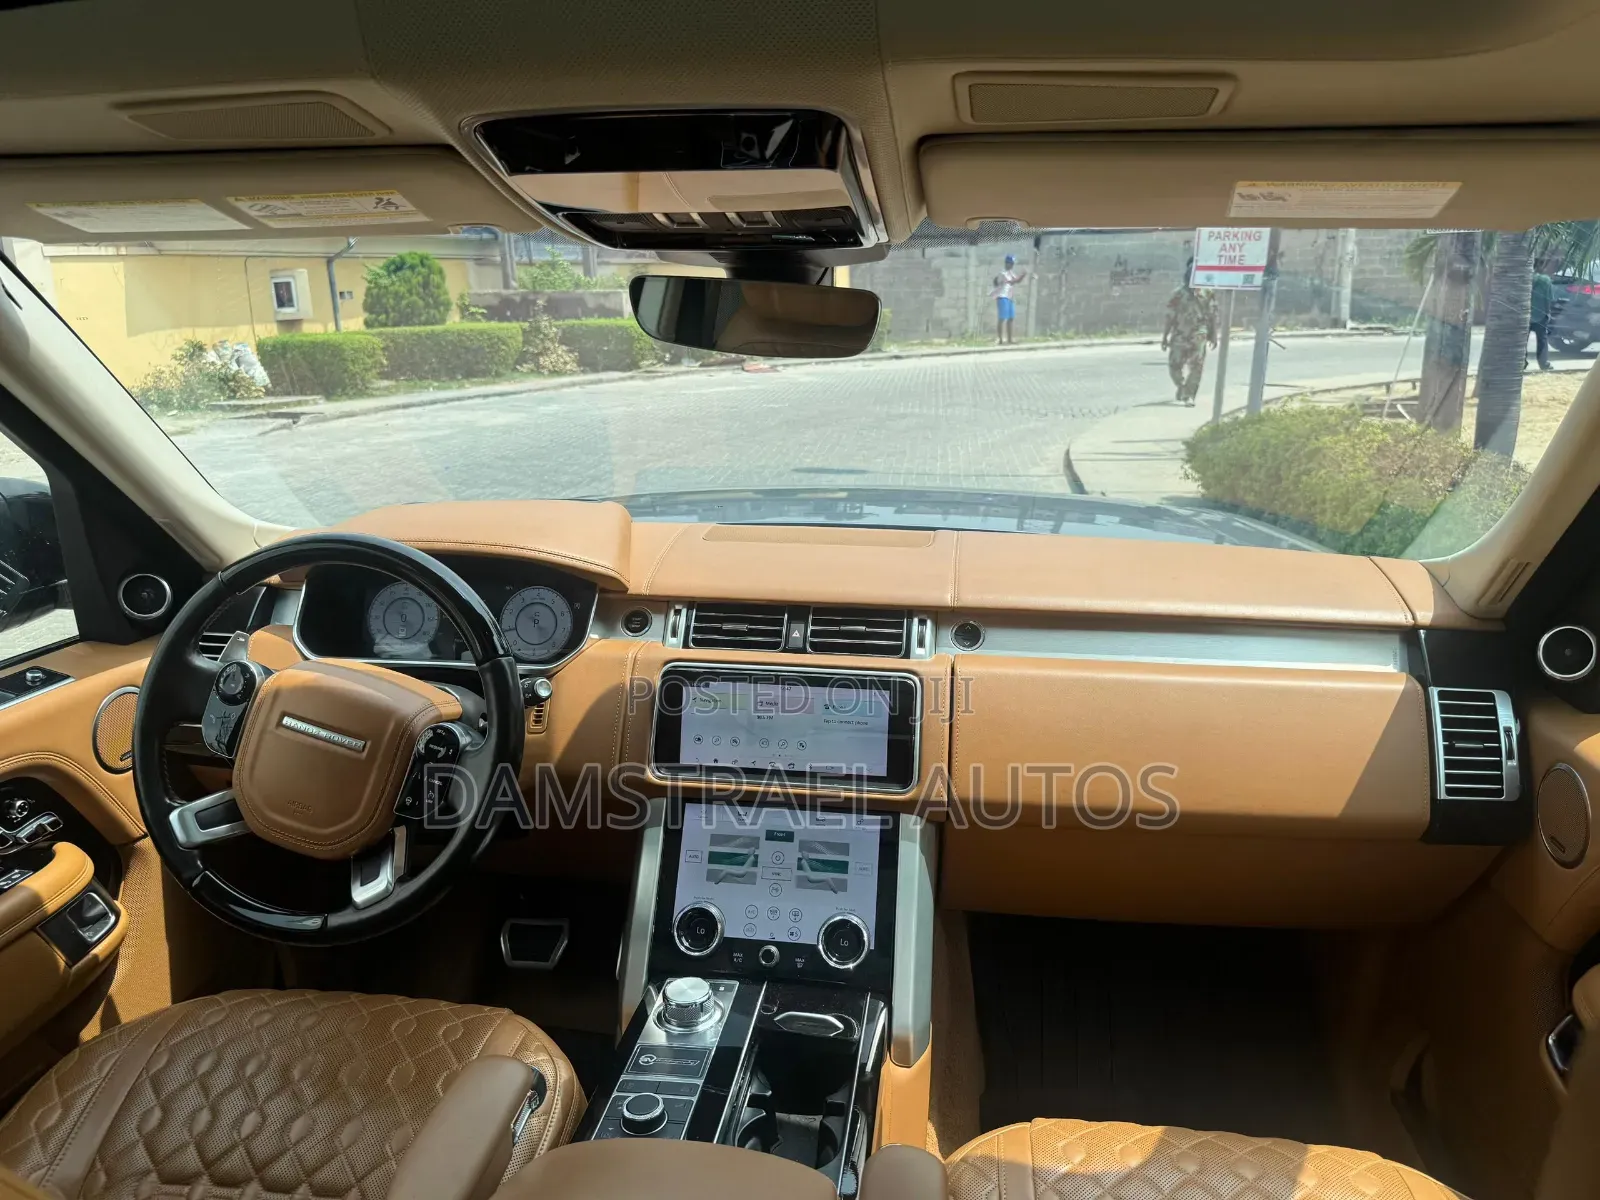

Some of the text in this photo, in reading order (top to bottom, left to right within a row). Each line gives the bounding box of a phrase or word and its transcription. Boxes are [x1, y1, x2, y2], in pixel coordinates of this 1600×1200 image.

[1207, 231, 1263, 241] PARKING
[1218, 243, 1246, 253] ANY
[1217, 255, 1246, 265] TIME
[533, 619, 540, 628] P
[284, 718, 364, 749] RANGE ROVER
[696, 926, 705, 935] Lo
[840, 938, 849, 947] Lo
